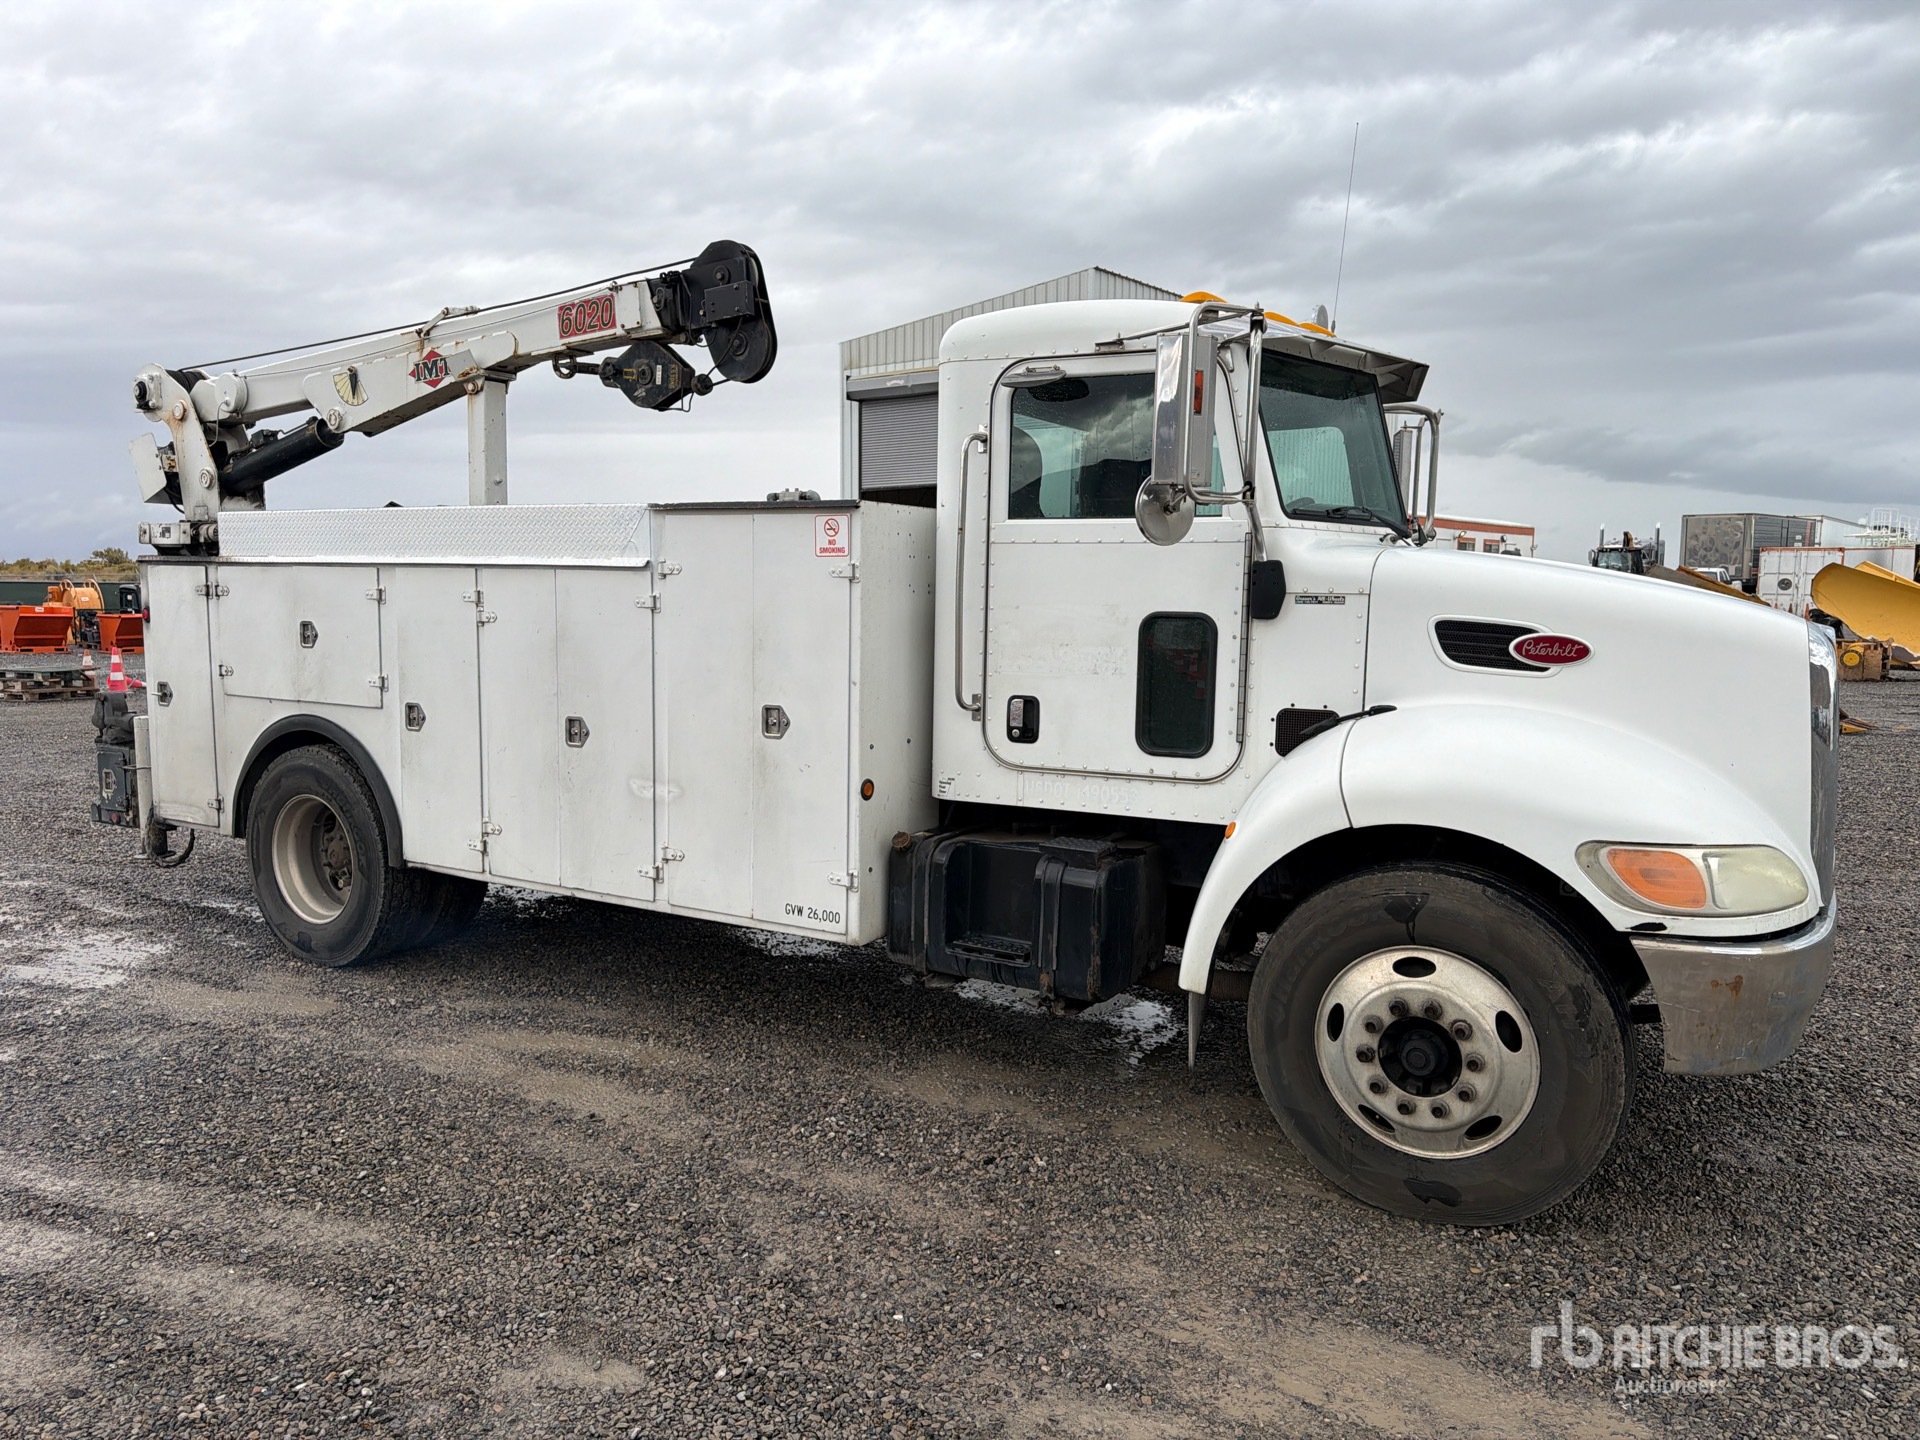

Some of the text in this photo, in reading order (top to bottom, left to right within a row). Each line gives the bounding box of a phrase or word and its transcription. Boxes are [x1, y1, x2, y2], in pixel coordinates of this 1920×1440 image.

[561, 297, 613, 335] 6020
[414, 357, 450, 382] IMT
[1522, 639, 1584, 657] Peterbilt
[785, 903, 841, 924] GVW 26,000
